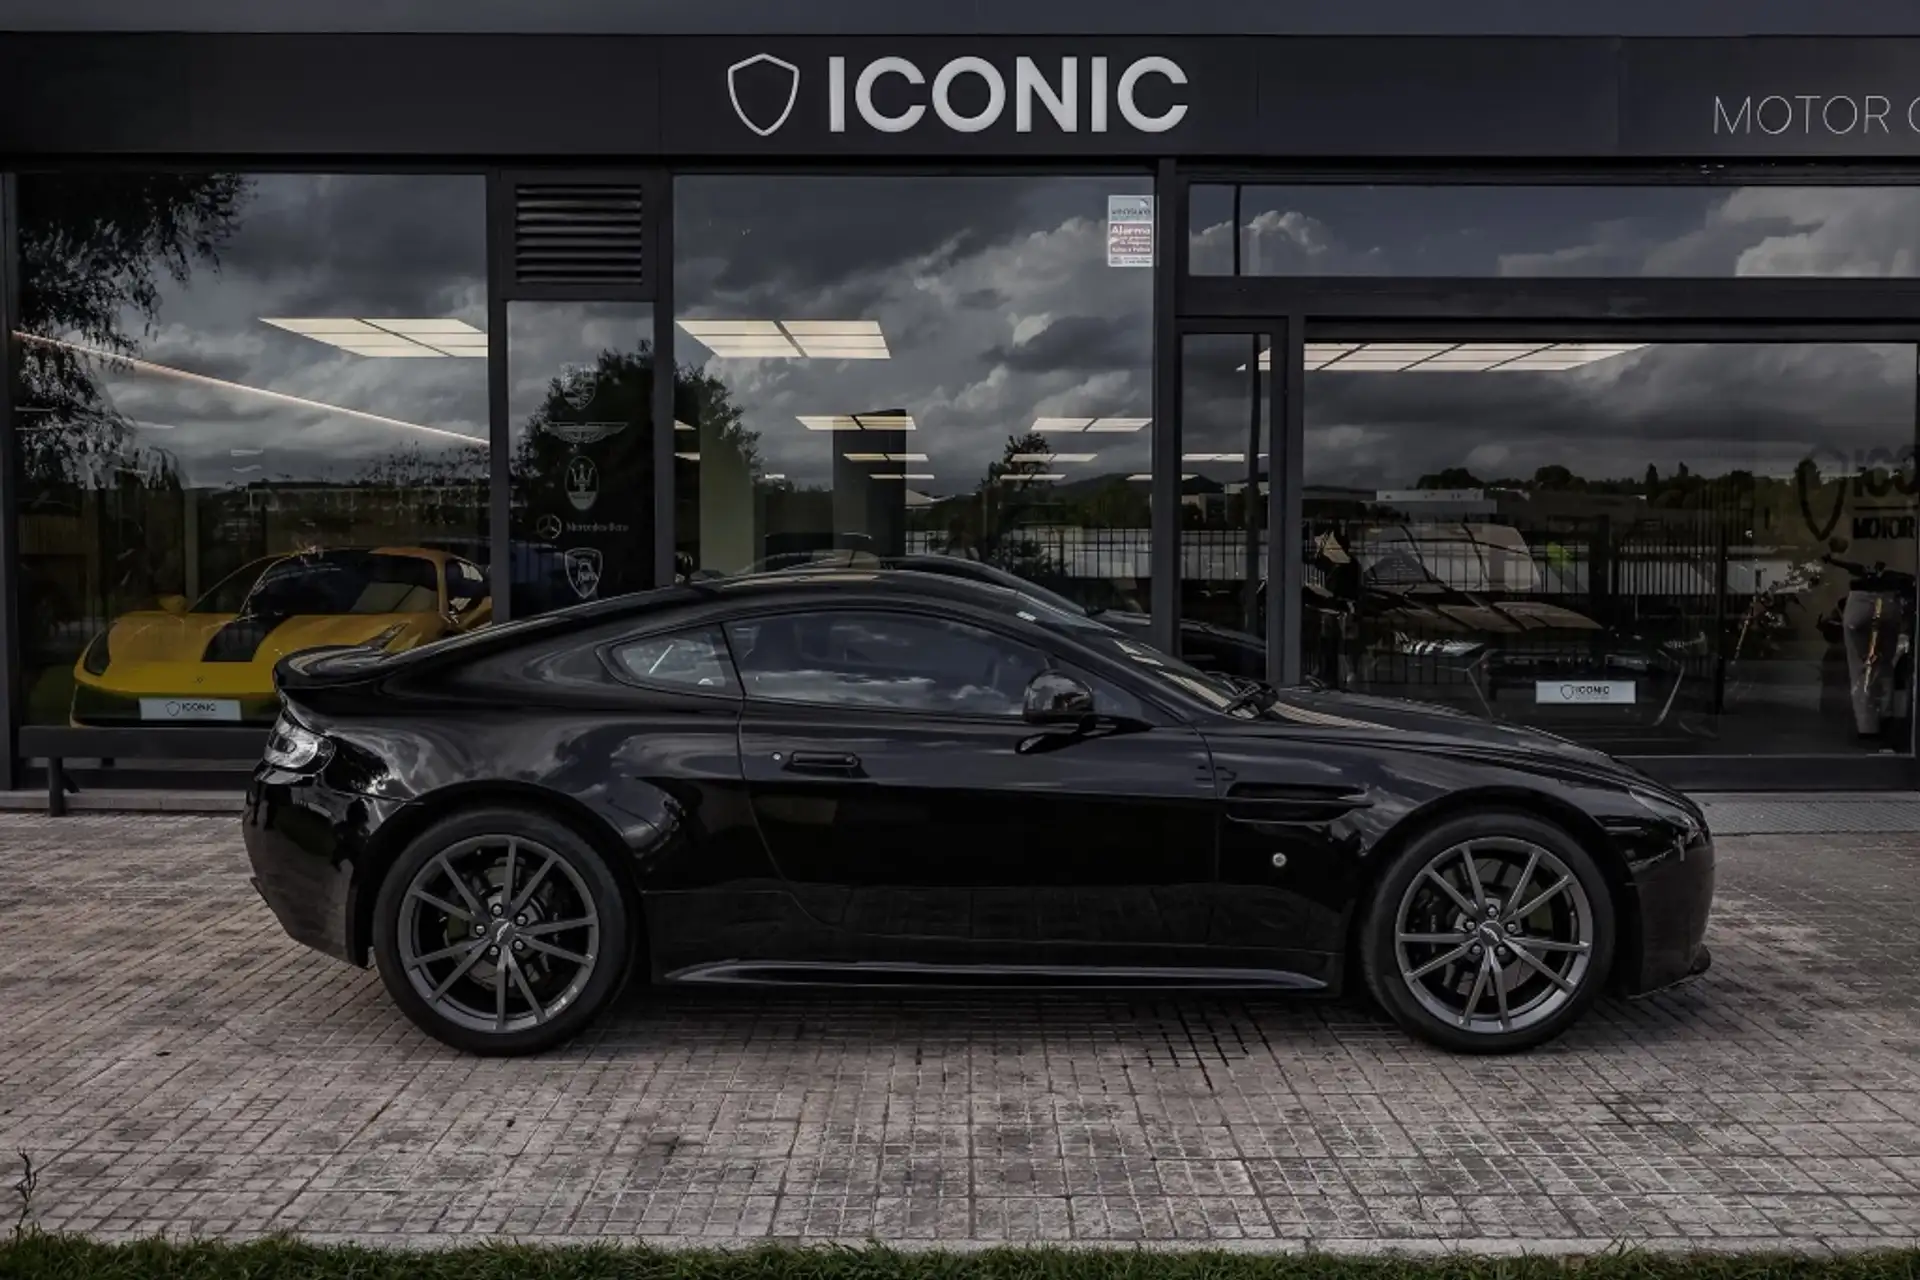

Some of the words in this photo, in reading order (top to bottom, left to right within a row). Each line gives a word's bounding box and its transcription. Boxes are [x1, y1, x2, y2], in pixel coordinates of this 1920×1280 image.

[829, 56, 1188, 132] ICONIC
[1713, 95, 1891, 135] MOTOR
[1853, 517, 1914, 539] MOTOR
[1576, 685, 1610, 695] ICONIC
[182, 703, 216, 712] ICONIC
